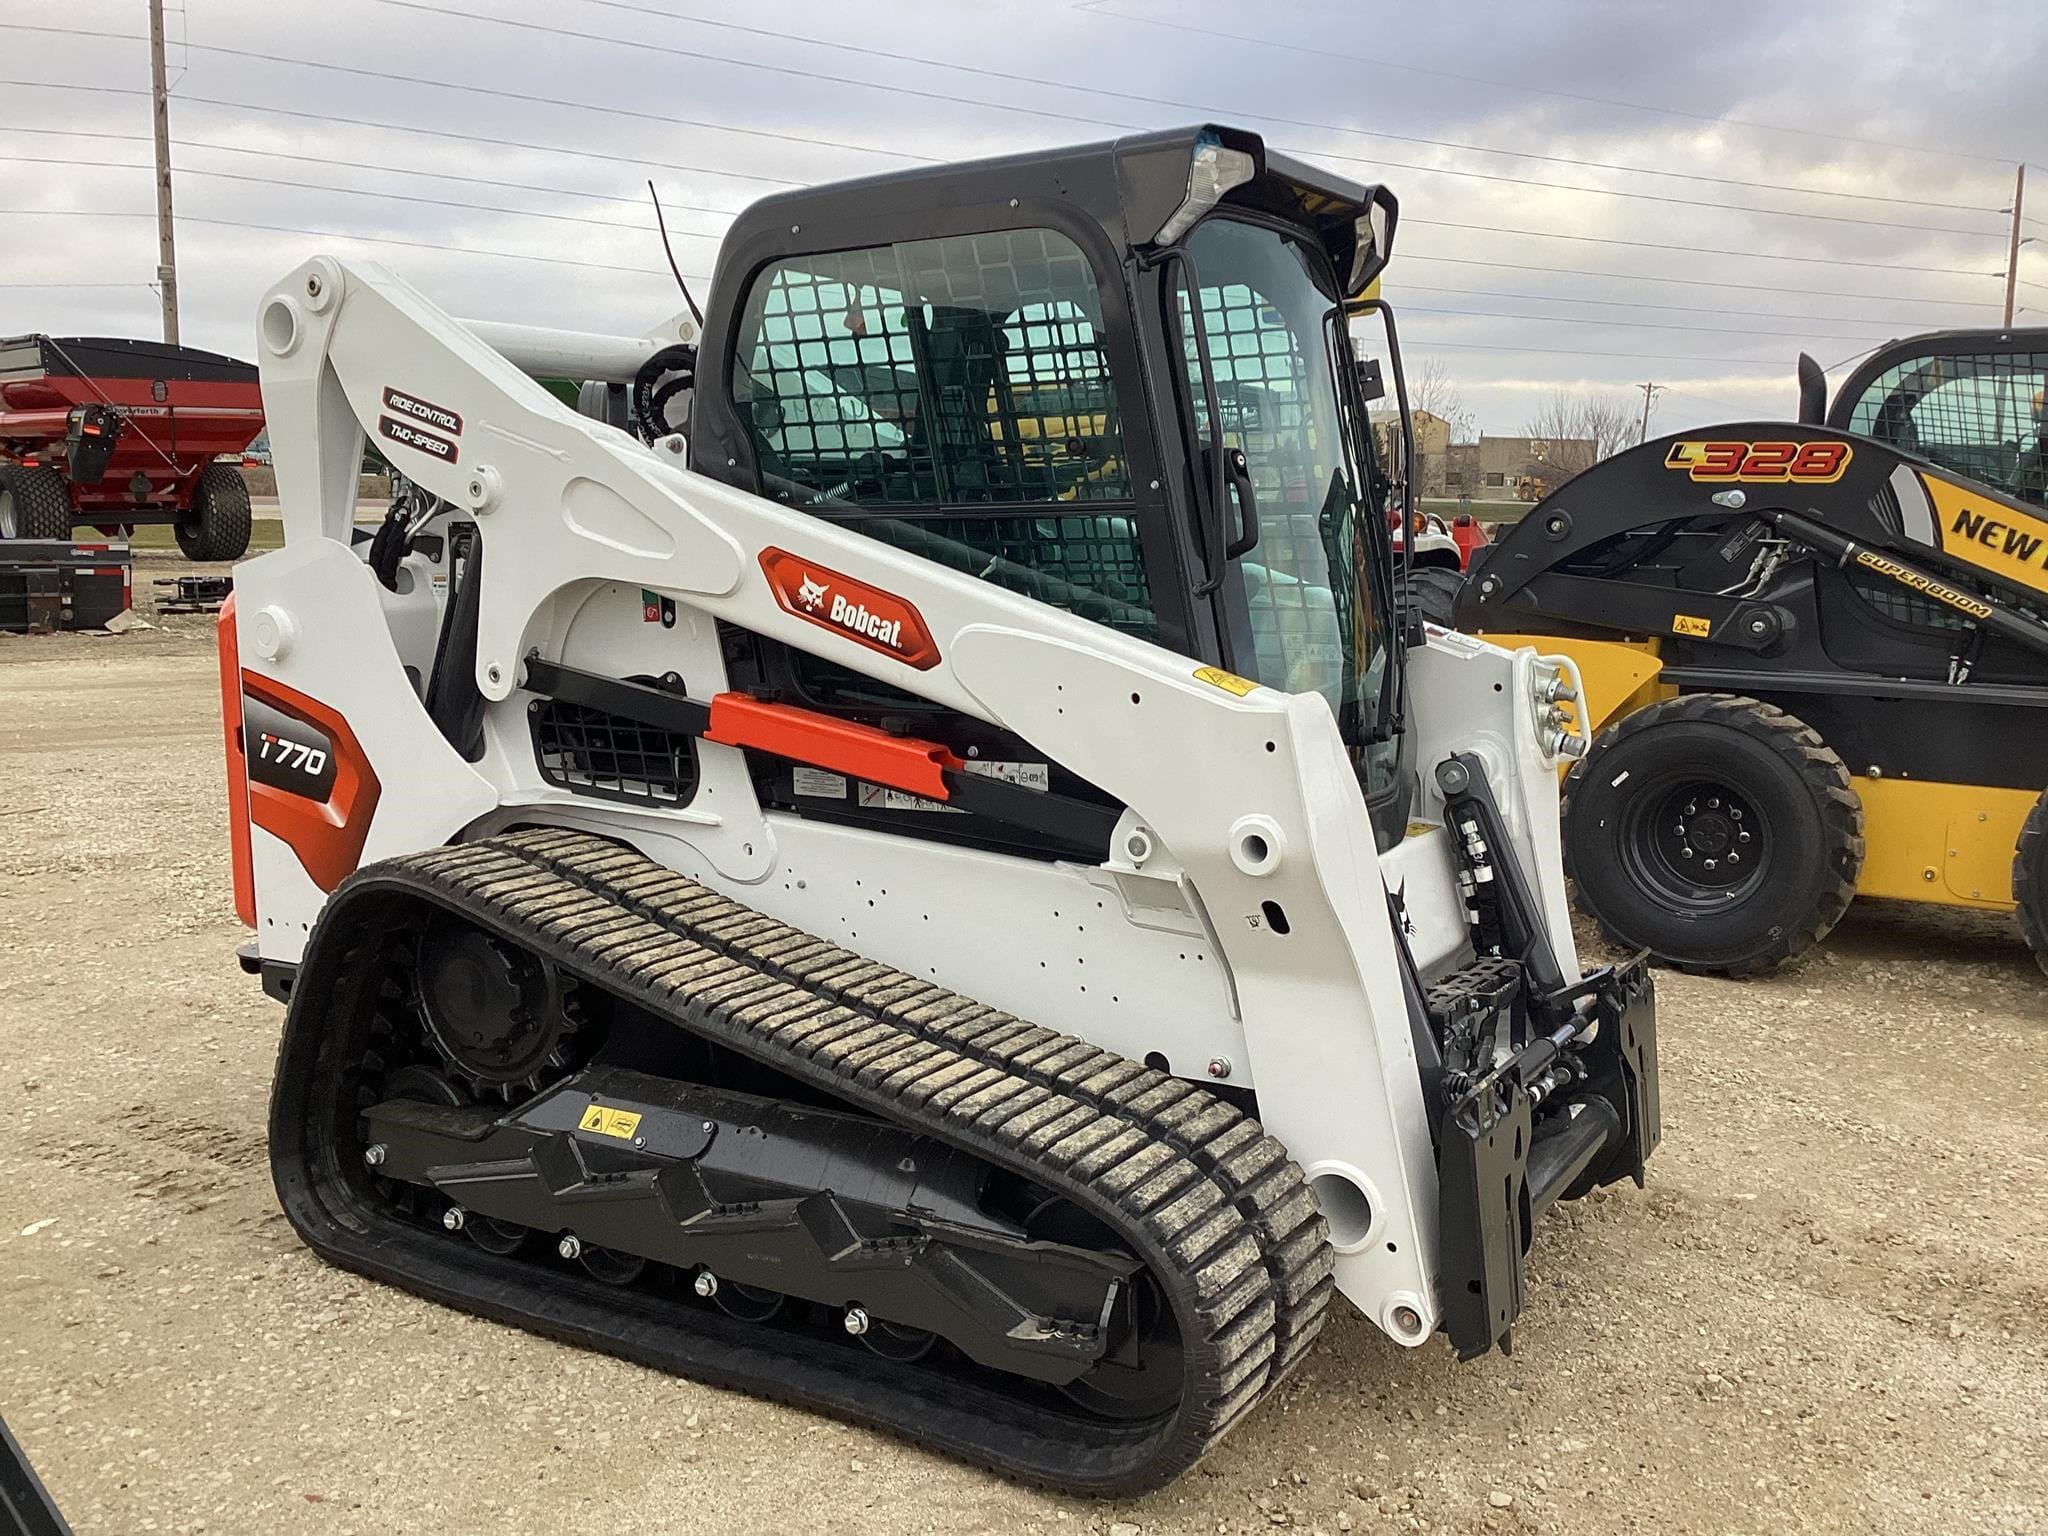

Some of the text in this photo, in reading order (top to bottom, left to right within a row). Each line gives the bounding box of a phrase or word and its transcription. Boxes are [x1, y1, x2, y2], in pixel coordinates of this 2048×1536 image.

[389, 394, 457, 430] RIDE CONTROL
[390, 424, 449, 455] TWO-SPEED
[1951, 508, 2043, 561] NEW
[1857, 552, 1992, 618] SUPER BOOM
[829, 594, 902, 648] Bobcat
